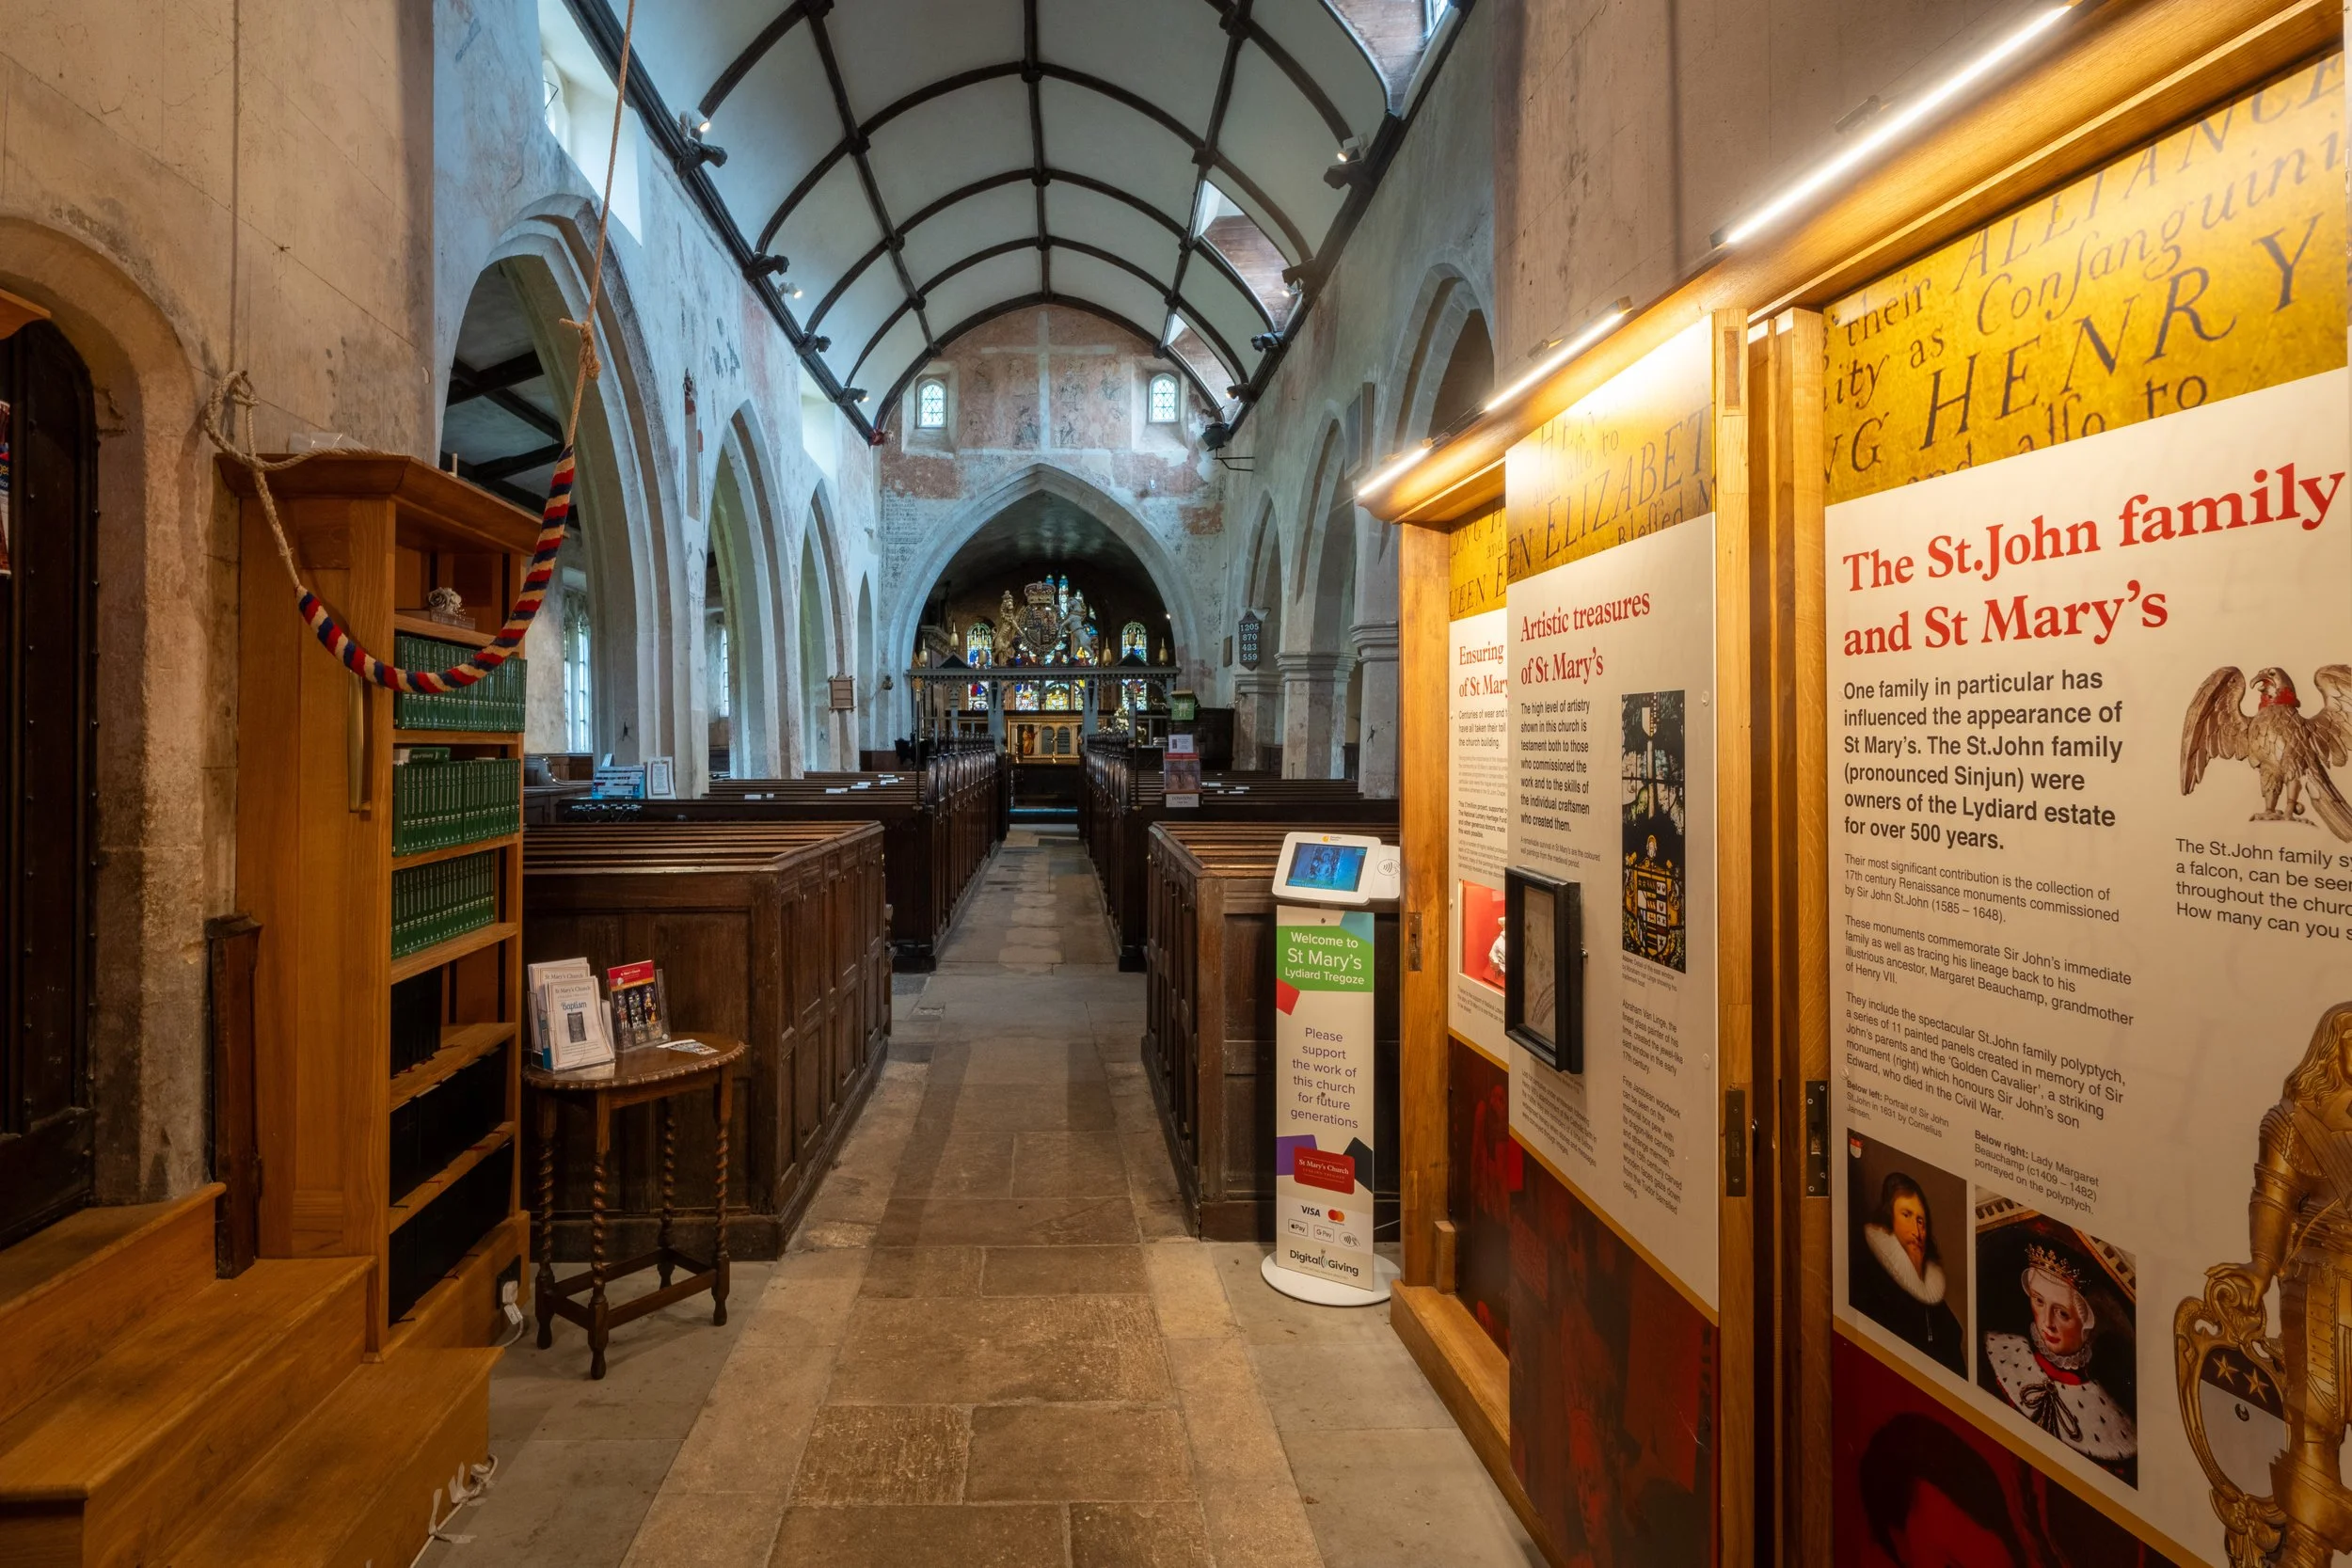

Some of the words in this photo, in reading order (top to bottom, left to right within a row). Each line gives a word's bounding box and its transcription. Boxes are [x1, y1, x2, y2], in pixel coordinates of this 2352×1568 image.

[1847, 277, 1932, 348] their
[1919, 212, 2326, 451] HENRY
[1909, 325, 1946, 369] as
[1842, 551, 1915, 593] The
[1927, 515, 2101, 581] St.John
[2118, 462, 2346, 546] family
[1240, 623, 1260, 631] 1205
[1520, 606, 1569, 642] Artistic
[1573, 592, 1651, 627] treasures
[1843, 611, 1912, 657] and
[1925, 605, 1968, 649] St
[1981, 579, 2169, 645] Mary’s
[1243, 653, 1258, 661] 559
[1459, 641, 1504, 666] Ensuring
[1520, 657, 1534, 686] of
[1535, 655, 1549, 684] St
[1552, 646, 1604, 685] Mary’s
[1459, 677, 1468, 697] of
[1470, 676, 1481, 696] St
[1844, 683, 1874, 700] One
[1879, 679, 1929, 701] family
[1935, 677, 1949, 695] in
[1958, 672, 2054, 696] particular
[2062, 670, 2103, 689] has
[1521, 704, 1531, 714] The
[1532, 702, 1543, 717] high
[1545, 701, 1558, 713] level
[1560, 700, 1565, 712] of
[1567, 699, 1590, 714] artistry
[1845, 707, 1927, 726] influenced
[1932, 706, 1961, 724] the
[1967, 707, 2090, 729] appearance
[2099, 701, 2122, 722] of
[1521, 721, 1538, 733] shown
[1539, 721, 1545, 732] in
[1546, 720, 1556, 732] this
[1558, 719, 1579, 732] church
[1581, 719, 1586, 732] is
[1521, 740, 1547, 751] testament
[1549, 739, 1561, 752] both
[1563, 740, 1569, 752] to
[1570, 739, 1588, 752] those
[1845, 736, 1859, 752] St
[1927, 736, 1961, 754] The
[1967, 736, 2043, 755] St.John
[2051, 736, 2122, 763] family
[1845, 763, 1947, 784] (pronounced
[1955, 766, 2024, 792] Sinjun)
[2031, 773, 2085, 790] were
[1520, 813, 1532, 824] who
[1533, 816, 1553, 828] created
[1554, 817, 1571, 832] them.
[1845, 794, 1900, 810] owners
[1907, 794, 1923, 812] of
[1929, 795, 1957, 815] the
[1963, 797, 2036, 821] Lydiard
[2044, 804, 2115, 827] estate
[1845, 816, 1866, 834] for
[1870, 823, 1905, 838] over
[1911, 823, 1940, 843] 500
[1947, 830, 2003, 849] years.
[2175, 838, 2204, 854] The
[2210, 841, 2273, 860] St.John
[2279, 847, 2332, 869] family
[1845, 853, 1866, 865] Their
[1868, 860, 1889, 869] most
[1891, 861, 1936, 877] significant
[1940, 869, 1998, 885] contribution
[2003, 875, 2011, 887] is
[2015, 877, 2032, 890] the
[2036, 880, 2093, 898] collection
[2098, 888, 2110, 900] of
[2176, 863, 2185, 873] a
[2190, 862, 2242, 881] falcon,
[2249, 871, 2279, 884] can
[2286, 871, 2309, 887] be
[1845, 884, 1855, 897] by
[1857, 886, 1868, 898] Sir
[1870, 889, 1891, 902] John
[1894, 893, 1929, 909] St.John
[1931, 898, 1960, 914] (1585
[1973, 906, 2006, 925] 1648).
[1846, 870, 1863, 880] 17th
[1865, 875, 1897, 889] century
[1899, 877, 1960, 896] Renaissance
[1963, 890, 2026, 907] monuments
[2030, 899, 2119, 922] commissioned
[2176, 881, 2264, 905] throughout
[2269, 893, 2297, 909] the
[2177, 902, 2211, 919] How
[2217, 911, 2262, 929] many
[2267, 918, 2299, 932] can
[2306, 923, 2339, 938] you
[1291, 932, 1343, 946] Welcome
[1346, 938, 1359, 948] to
[1287, 948, 1304, 964] St
[1308, 949, 1362, 972] Mary’s
[1285, 967, 1320, 979] Lydiard
[1324, 971, 1364, 985] Tregoze
[1305, 1027, 1343, 1042] Please
[1302, 1045, 1346, 1059] support
[1292, 1058, 1311, 1070] the
[1313, 1065, 1342, 1075] work
[1344, 1068, 1357, 1078] of
[1293, 1075, 1313, 1087] this
[1316, 1079, 1356, 1094] church
[1297, 1092, 1313, 1103] for
[1316, 1095, 1351, 1110] future
[1290, 1109, 1359, 1129] generations
[1327, 1164, 1349, 1175] Church
[1975, 1130, 2001, 1148] Below
[2004, 1143, 2028, 1159] right:
[2031, 1152, 2053, 1170] Lady
[2056, 1162, 2098, 1187] Margaret
[1300, 1205, 1321, 1217] VISA
[1295, 1224, 1306, 1233] Pay
[1322, 1229, 1332, 1238] Pay
[1290, 1249, 1321, 1265] Digital
[1327, 1259, 1359, 1276] Giving
